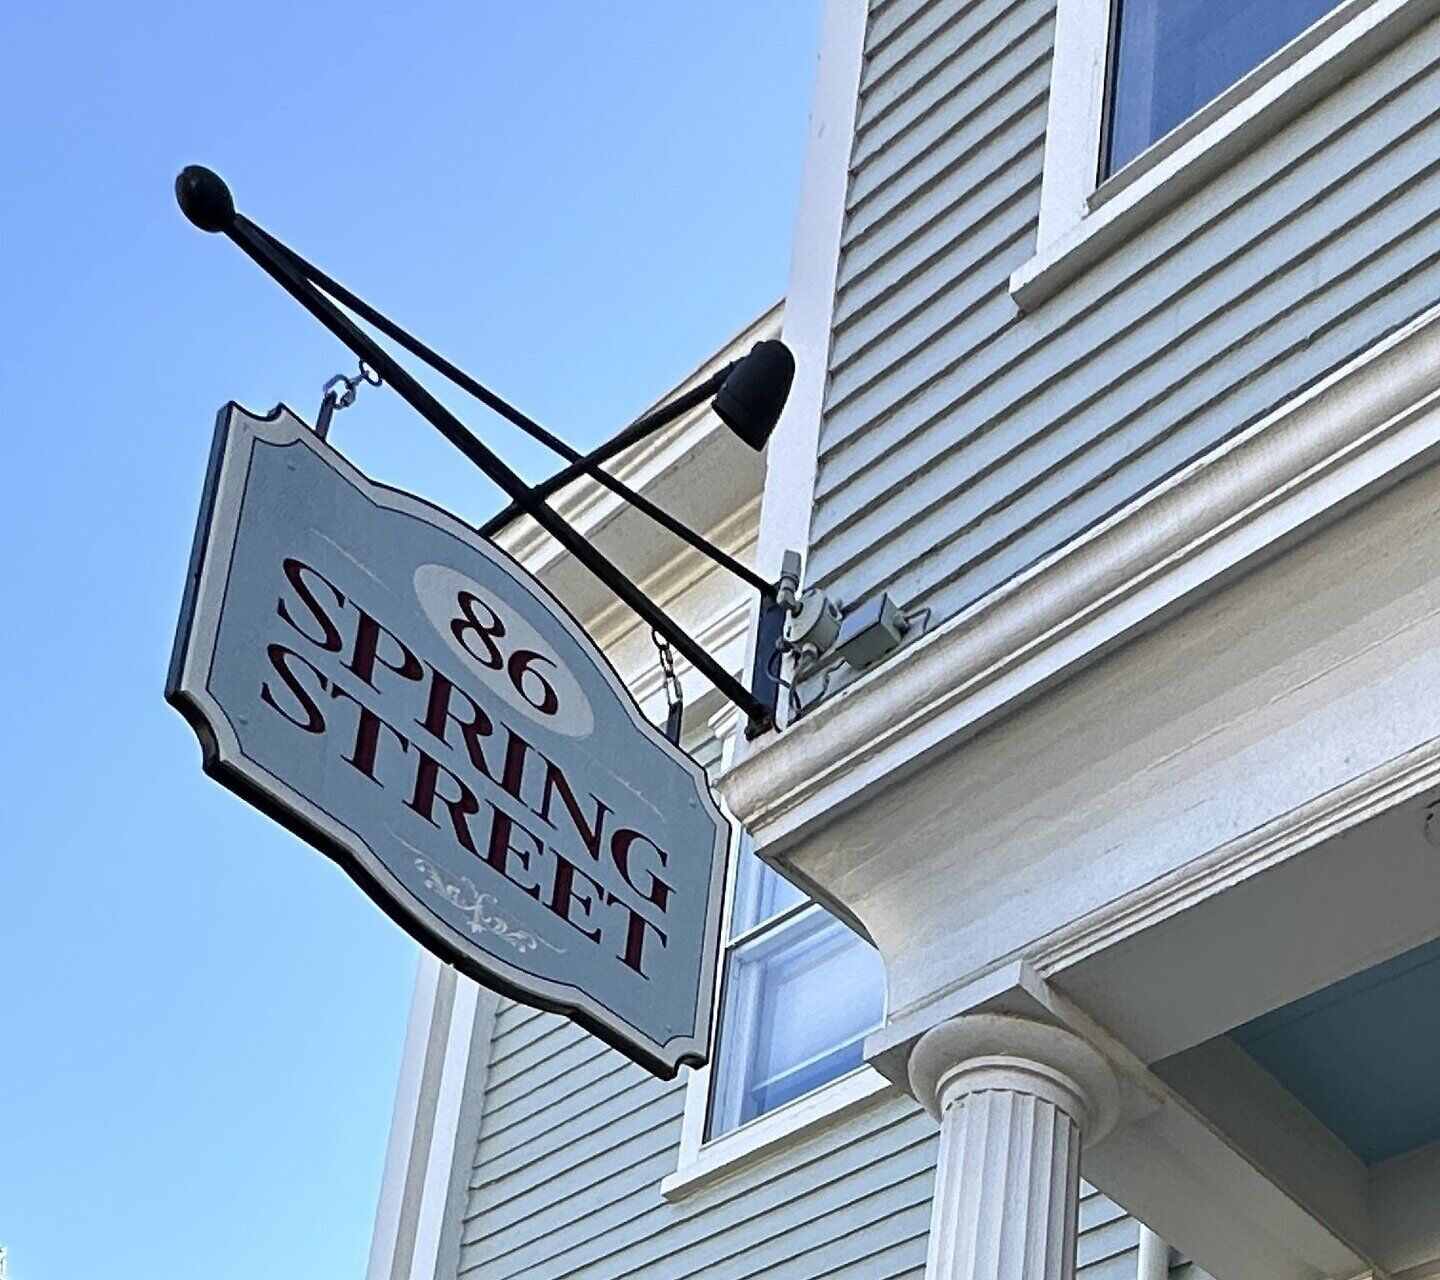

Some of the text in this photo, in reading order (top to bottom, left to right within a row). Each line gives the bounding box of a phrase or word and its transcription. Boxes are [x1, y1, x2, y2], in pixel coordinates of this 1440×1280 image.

[259, 642, 669, 981] STREET
[276, 556, 678, 915] SPRING
[449, 589, 559, 717] 86
